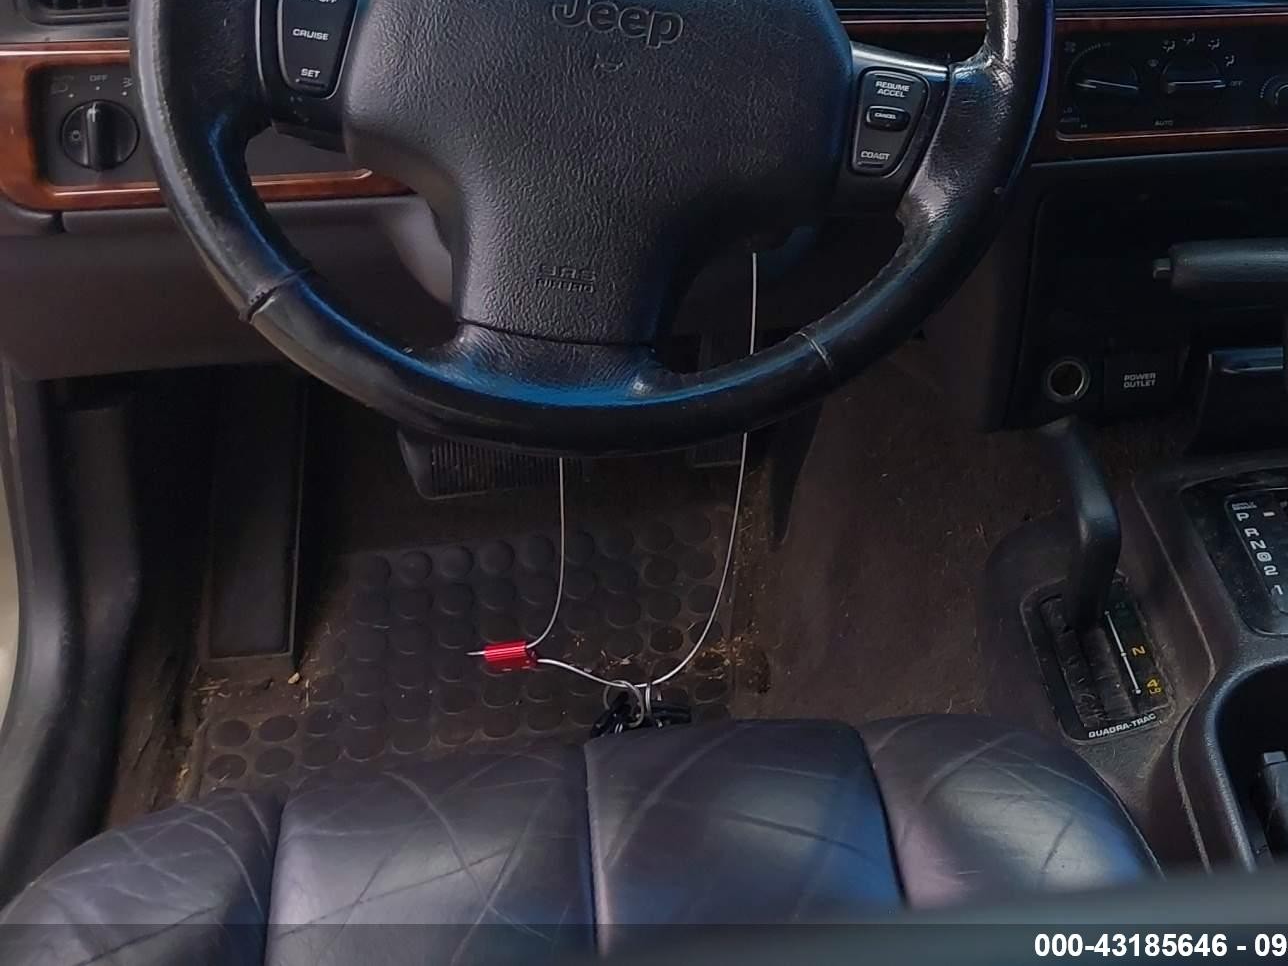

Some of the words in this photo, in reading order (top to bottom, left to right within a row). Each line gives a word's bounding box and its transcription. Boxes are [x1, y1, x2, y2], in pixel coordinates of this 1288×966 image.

[292, 28, 329, 40] CRUISE
[301, 68, 320, 78] SET
[875, 81, 910, 91] RESUME
[877, 88, 906, 98] ACCEL
[860, 151, 890, 160] COAST
[1124, 373, 1156, 381] POWER
[1123, 379, 1156, 388] OUTLET
[1236, 512, 1250, 521] P
[1244, 527, 1260, 537] R
[1250, 540, 1267, 550] N
[1263, 565, 1279, 575] 2
[1132, 645, 1146, 656] N
[1088, 713, 1157, 738] QUADRA-TRAC
